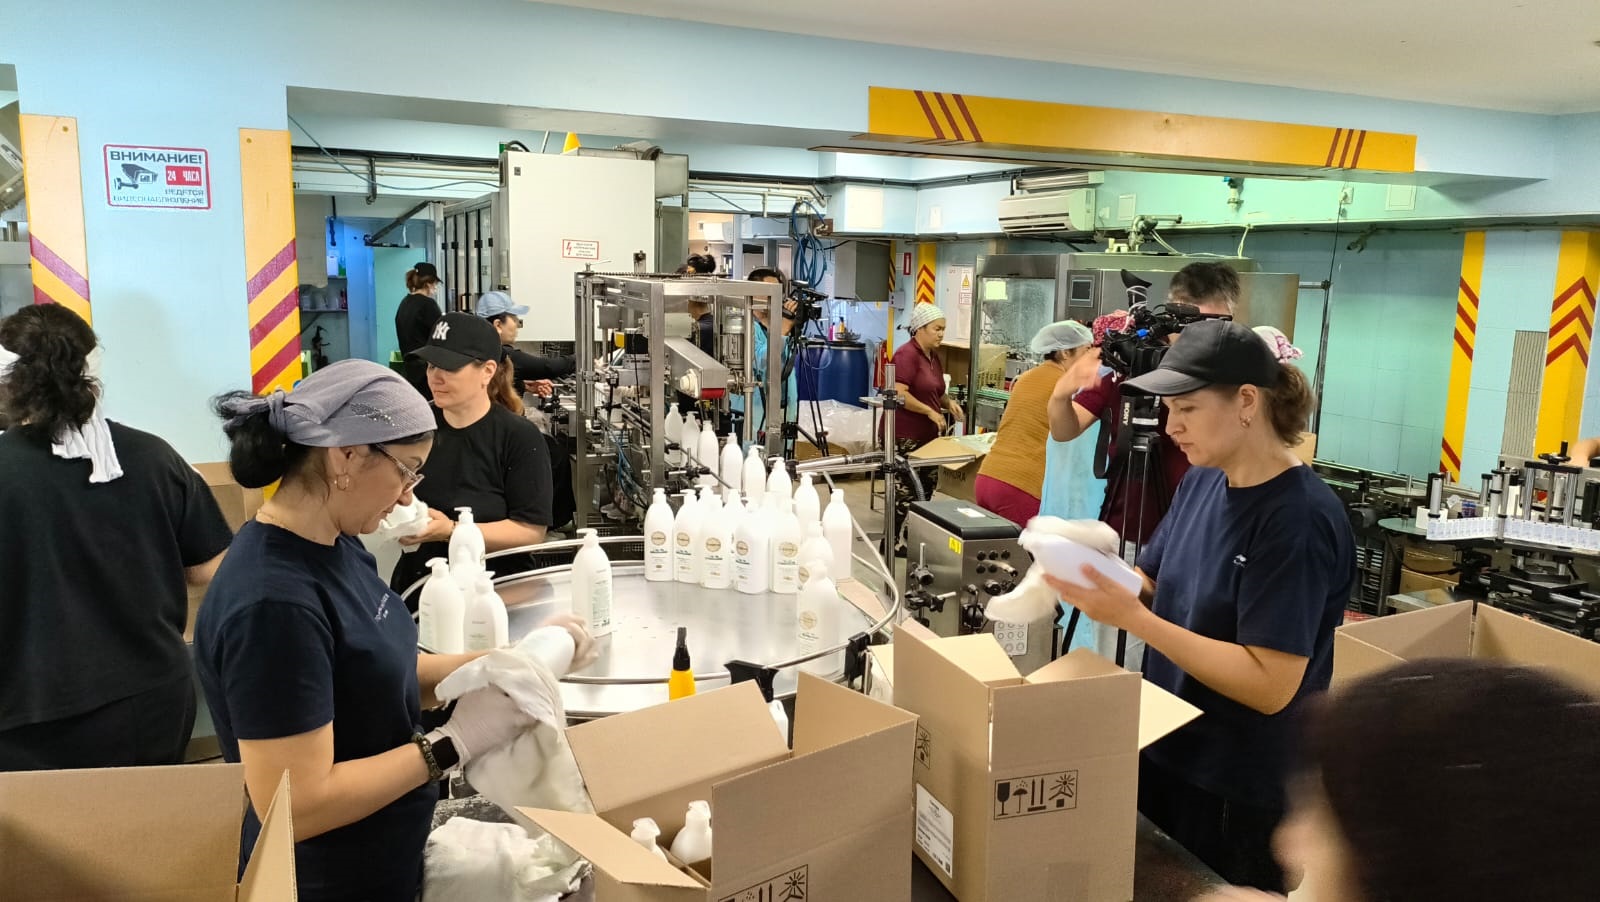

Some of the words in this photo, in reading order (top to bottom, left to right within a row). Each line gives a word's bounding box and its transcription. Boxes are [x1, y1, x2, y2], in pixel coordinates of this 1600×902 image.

[110, 151, 203, 164] ВНИМАНИЕ!
[167, 170, 177, 181] 24
[183, 170, 201, 182] ЧАСА
[1122, 402, 1130, 426] SONY
